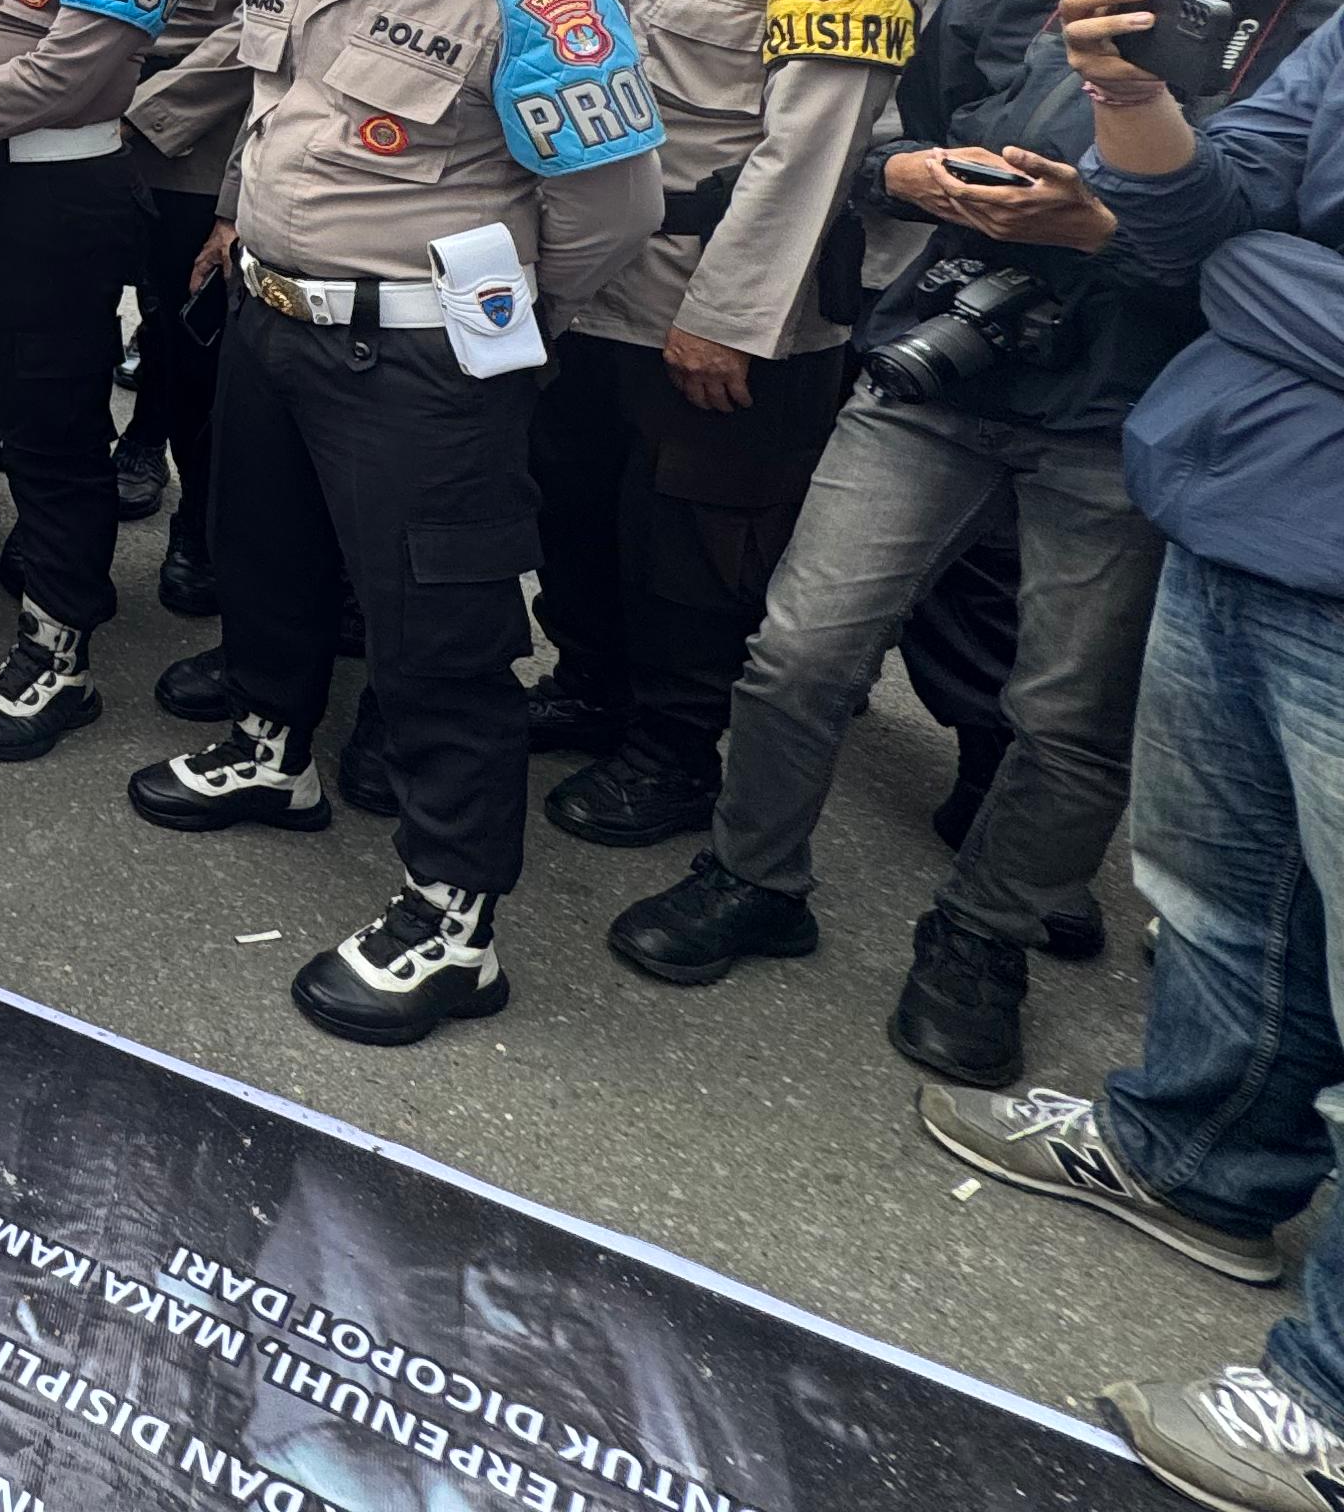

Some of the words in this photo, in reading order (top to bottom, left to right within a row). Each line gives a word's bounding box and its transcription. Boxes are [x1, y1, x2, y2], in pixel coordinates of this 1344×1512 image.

[369, 14, 463, 66] POLRI
[861, 14, 912, 61] RW
[1221, 18, 1260, 70] Canon
[104, 1269, 247, 1361] MAKA
[167, 1246, 290, 1323] DARI
[297, 1307, 546, 1445] DICOPOT
[179, 1436, 305, 1512] DAN
[557, 1423, 761, 1512] NTUK
